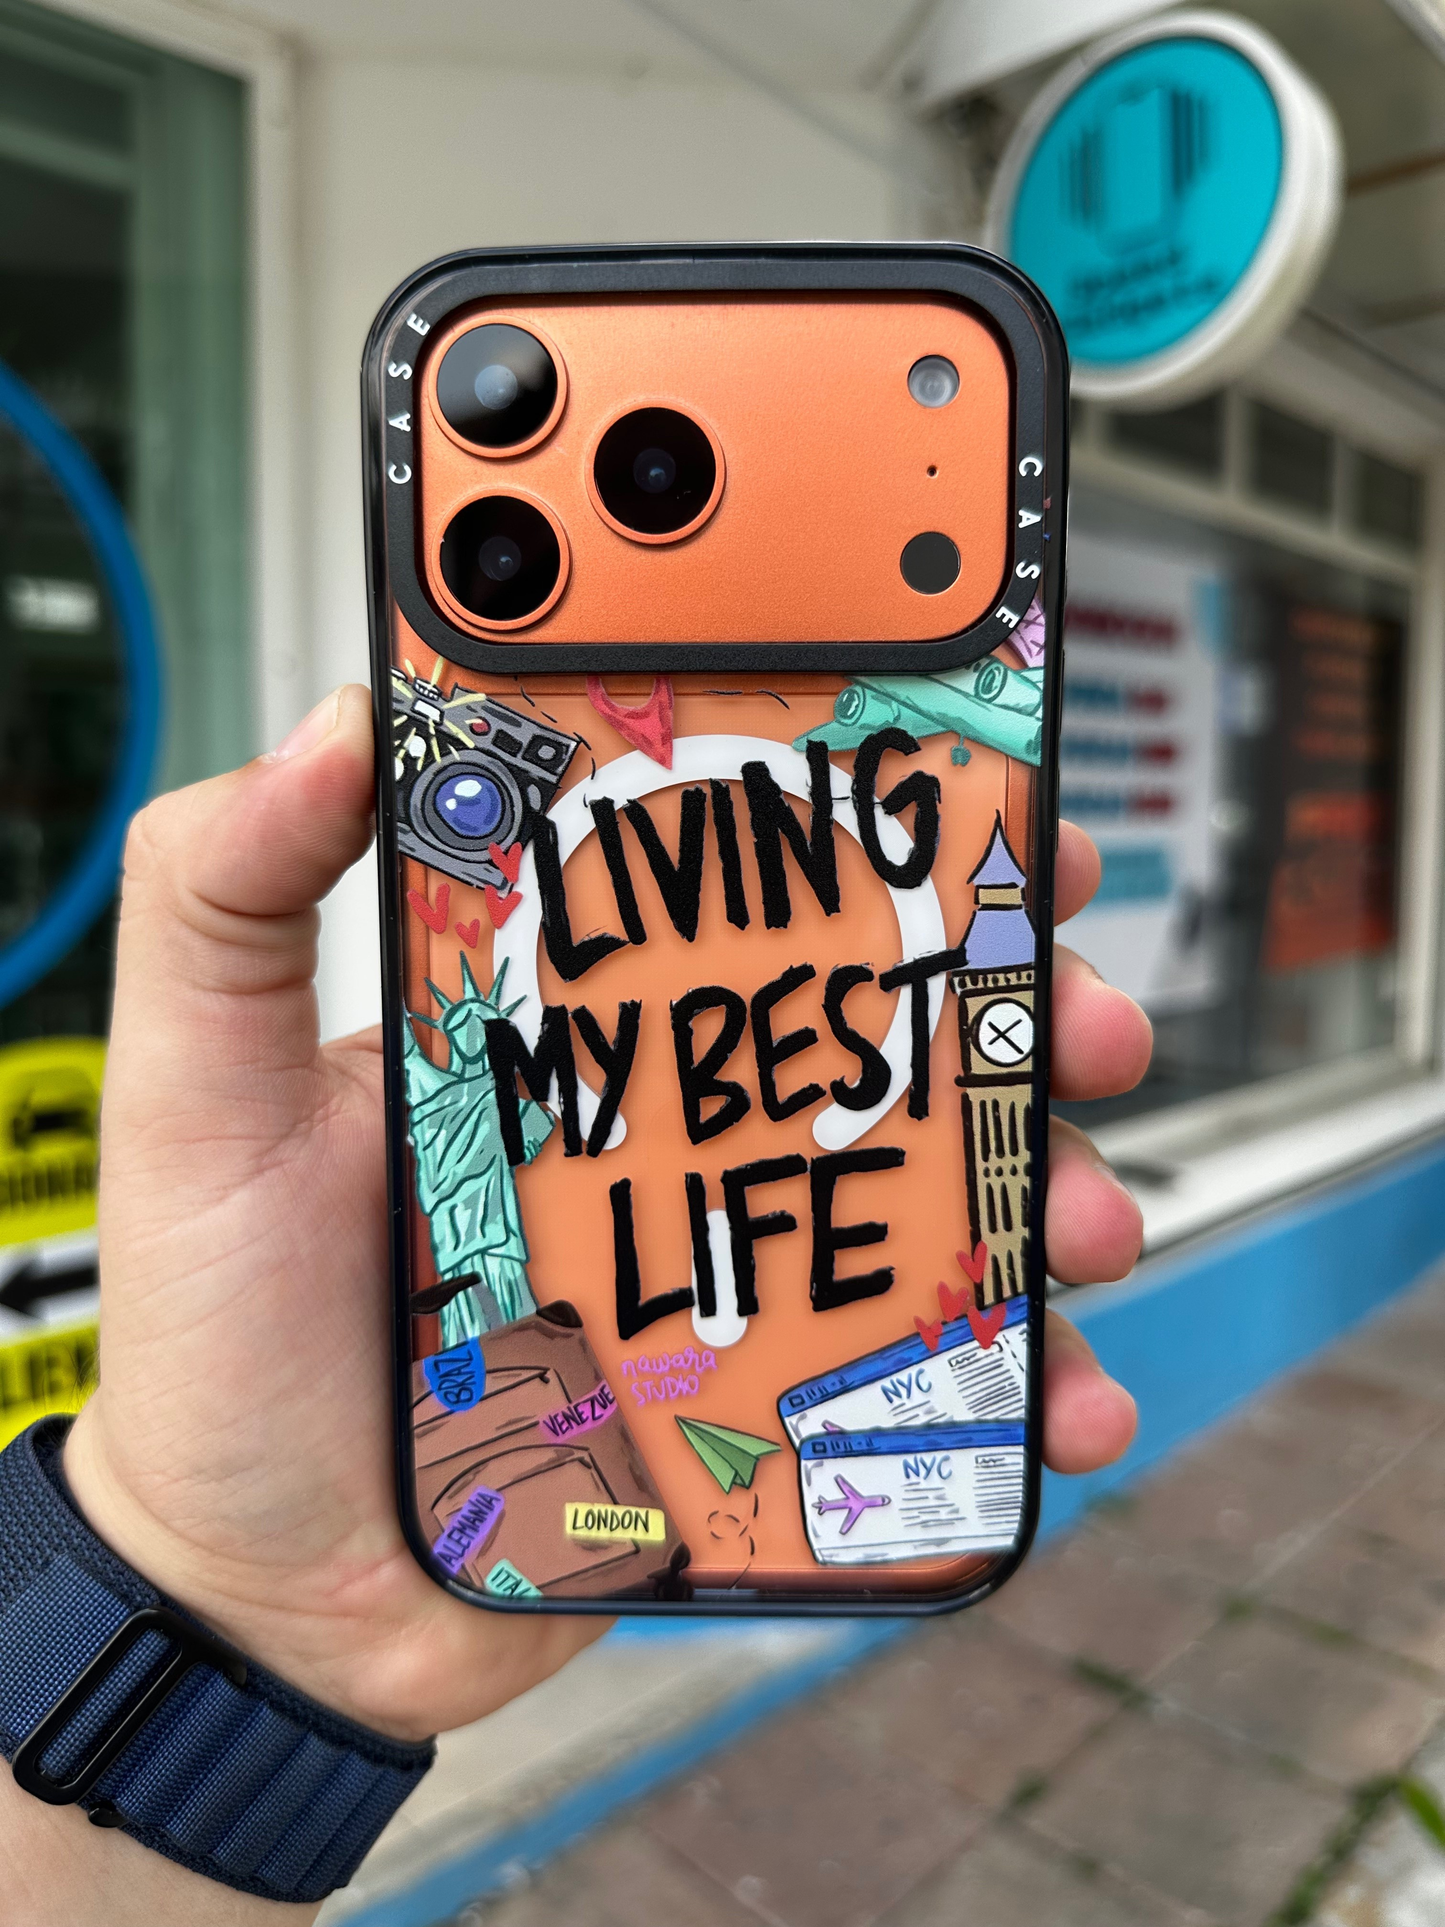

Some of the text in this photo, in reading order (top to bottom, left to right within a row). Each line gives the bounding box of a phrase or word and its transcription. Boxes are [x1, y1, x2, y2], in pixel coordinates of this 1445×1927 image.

[387, 313, 432, 485] CASE
[995, 456, 1043, 629] CASE
[528, 727, 942, 983] LIVING
[484, 948, 968, 1166] MY BEST
[608, 1147, 906, 1340] LIFE
[880, 1367, 933, 1405] NYC
[902, 1454, 953, 1481] NYC
[436, 1491, 502, 1568] ALEMANIA
[572, 1508, 650, 1533] LONDON
